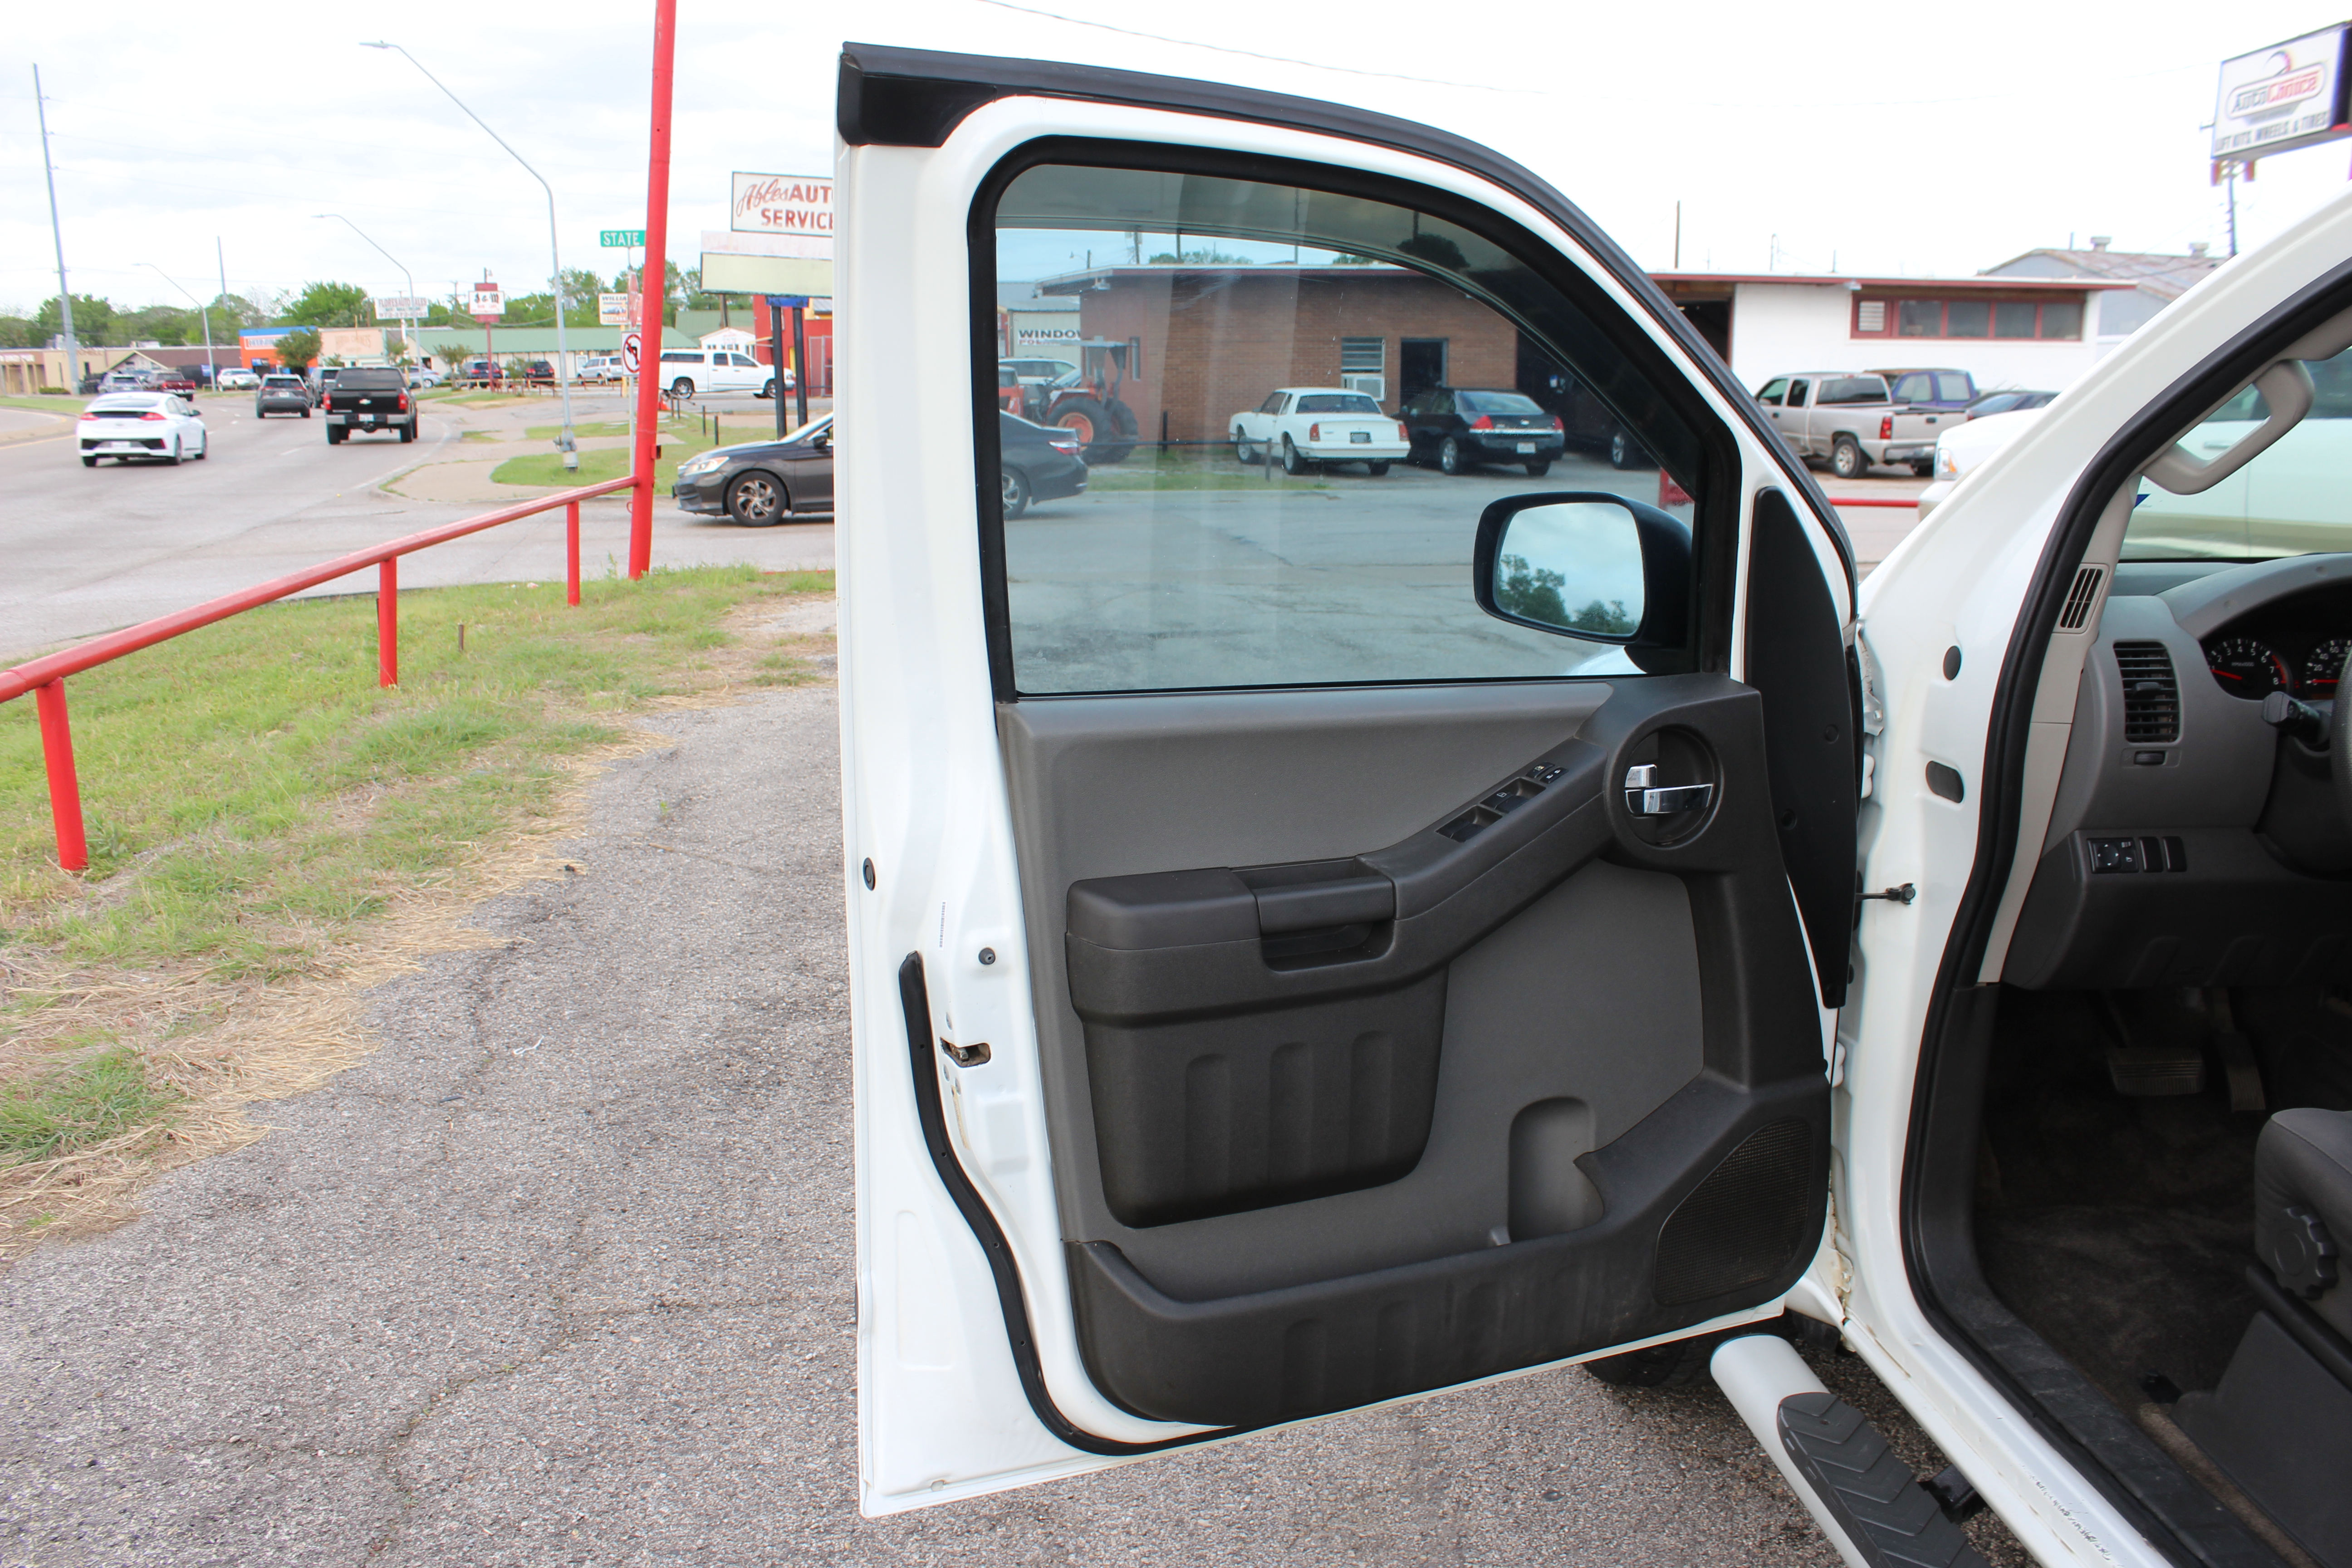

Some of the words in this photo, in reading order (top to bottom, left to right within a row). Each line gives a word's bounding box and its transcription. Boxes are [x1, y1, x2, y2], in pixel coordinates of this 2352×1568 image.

[736, 178, 789, 217] Ables
[789, 184, 833, 204] AUT
[603, 231, 640, 246] STATE
